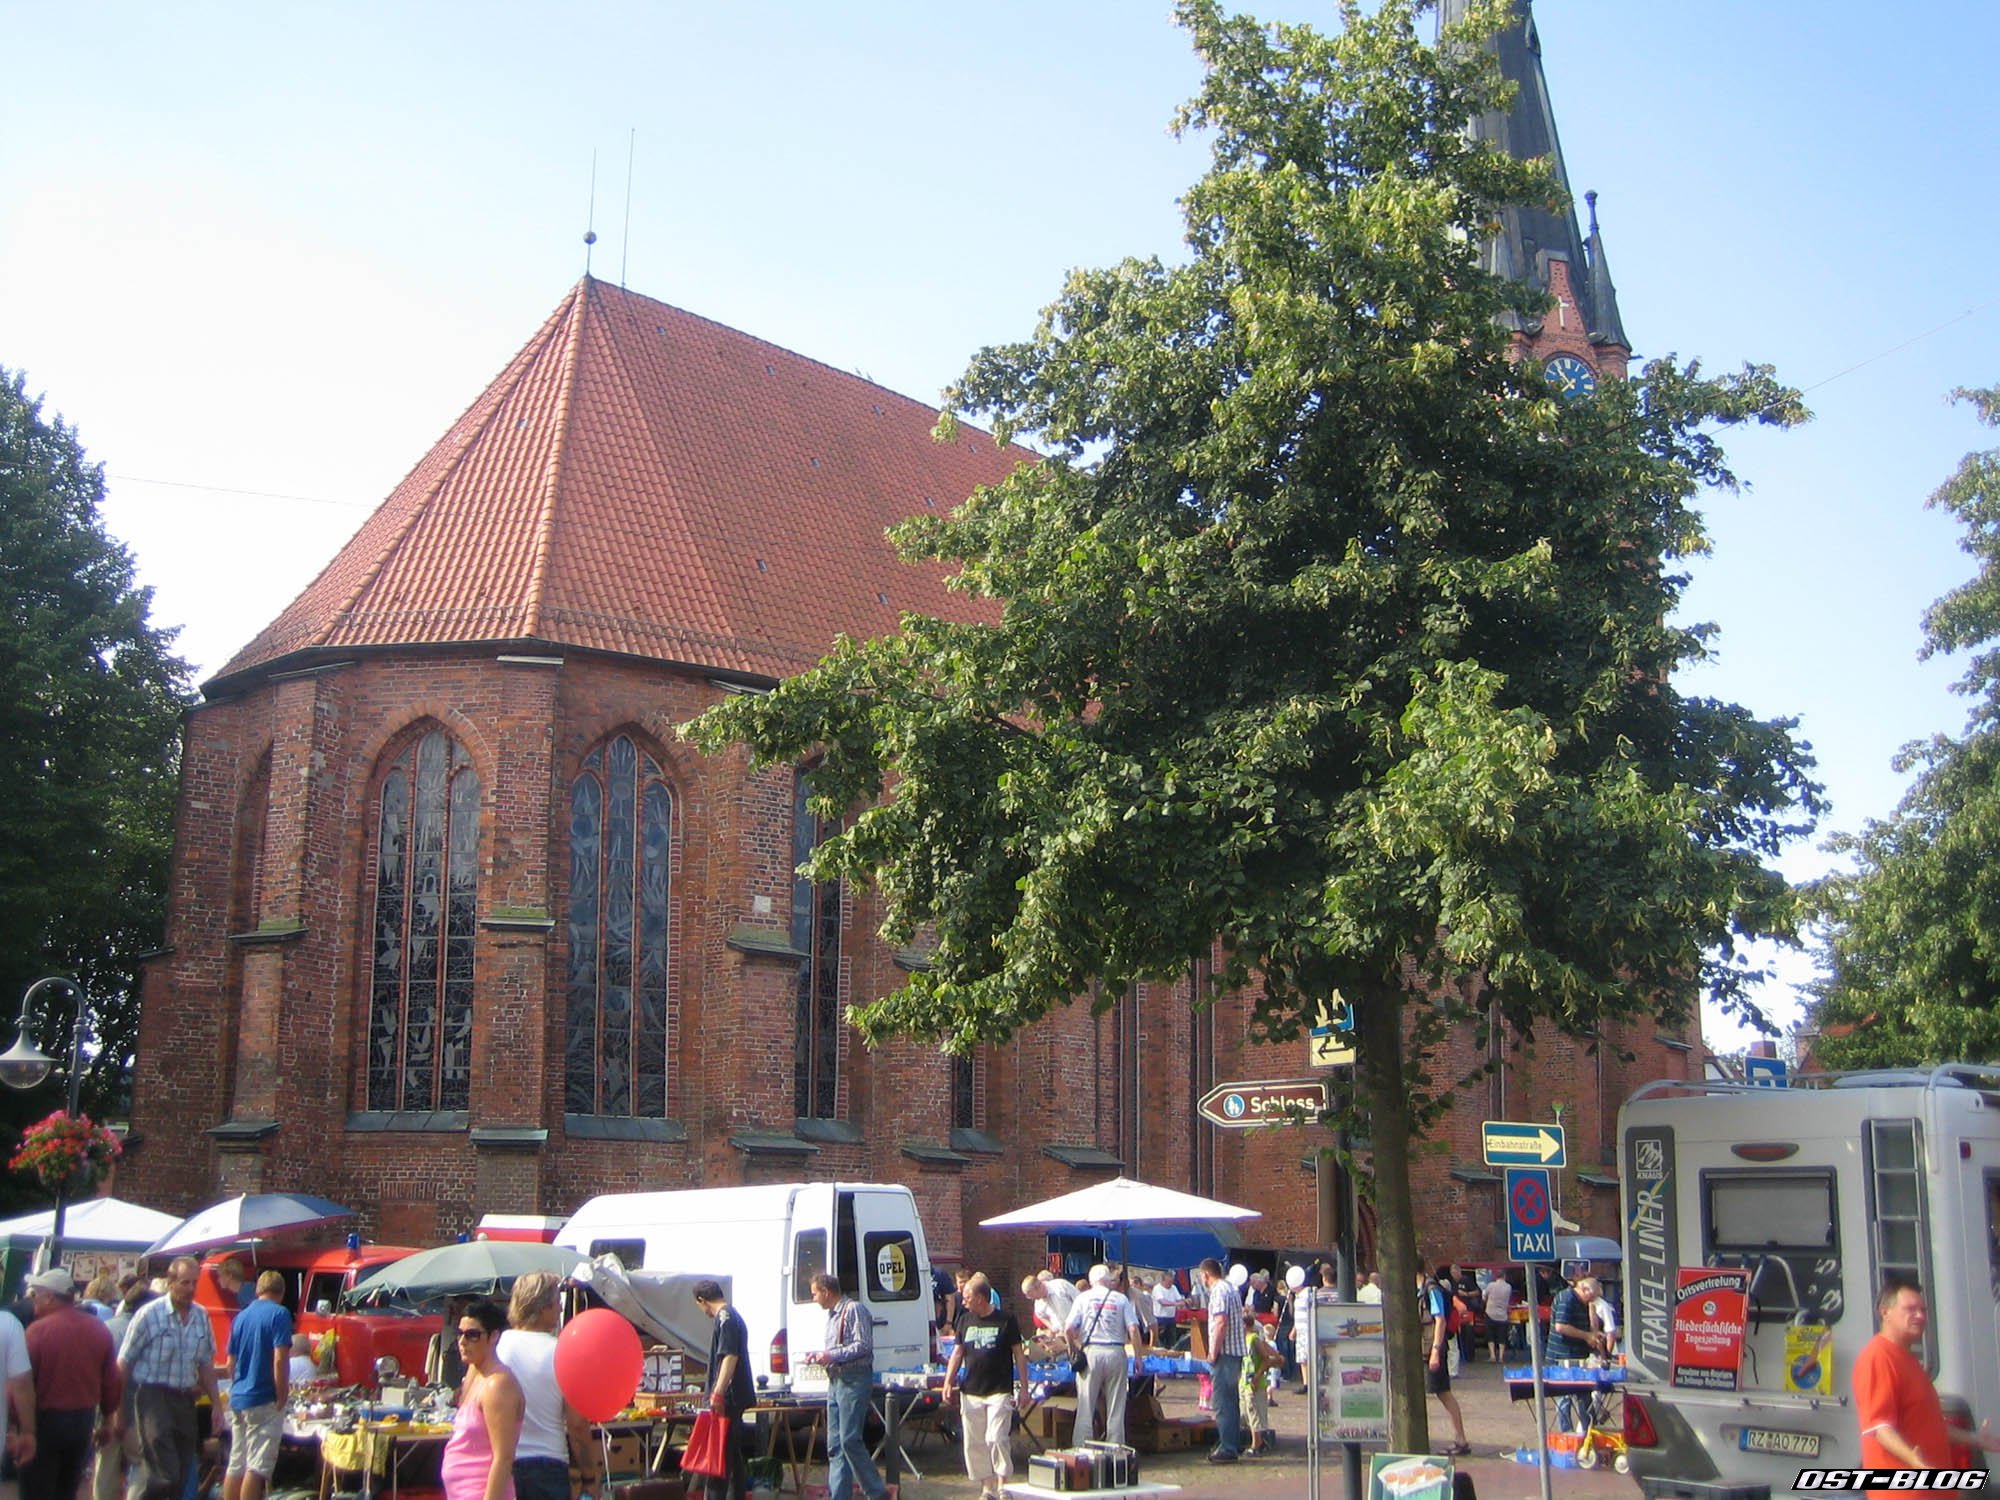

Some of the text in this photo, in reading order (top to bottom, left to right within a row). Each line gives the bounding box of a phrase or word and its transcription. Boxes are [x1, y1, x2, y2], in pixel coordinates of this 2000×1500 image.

[1487, 1138, 1542, 1151] Einbahnstraße
[1513, 1233, 1550, 1252] TAXI
[879, 1261, 904, 1275] OPEL
[1637, 1189, 1669, 1363] TRAVEL-LINER
[1677, 1275, 1741, 1300] Ortsvertretung
[1749, 1431, 1764, 1448] RZ
